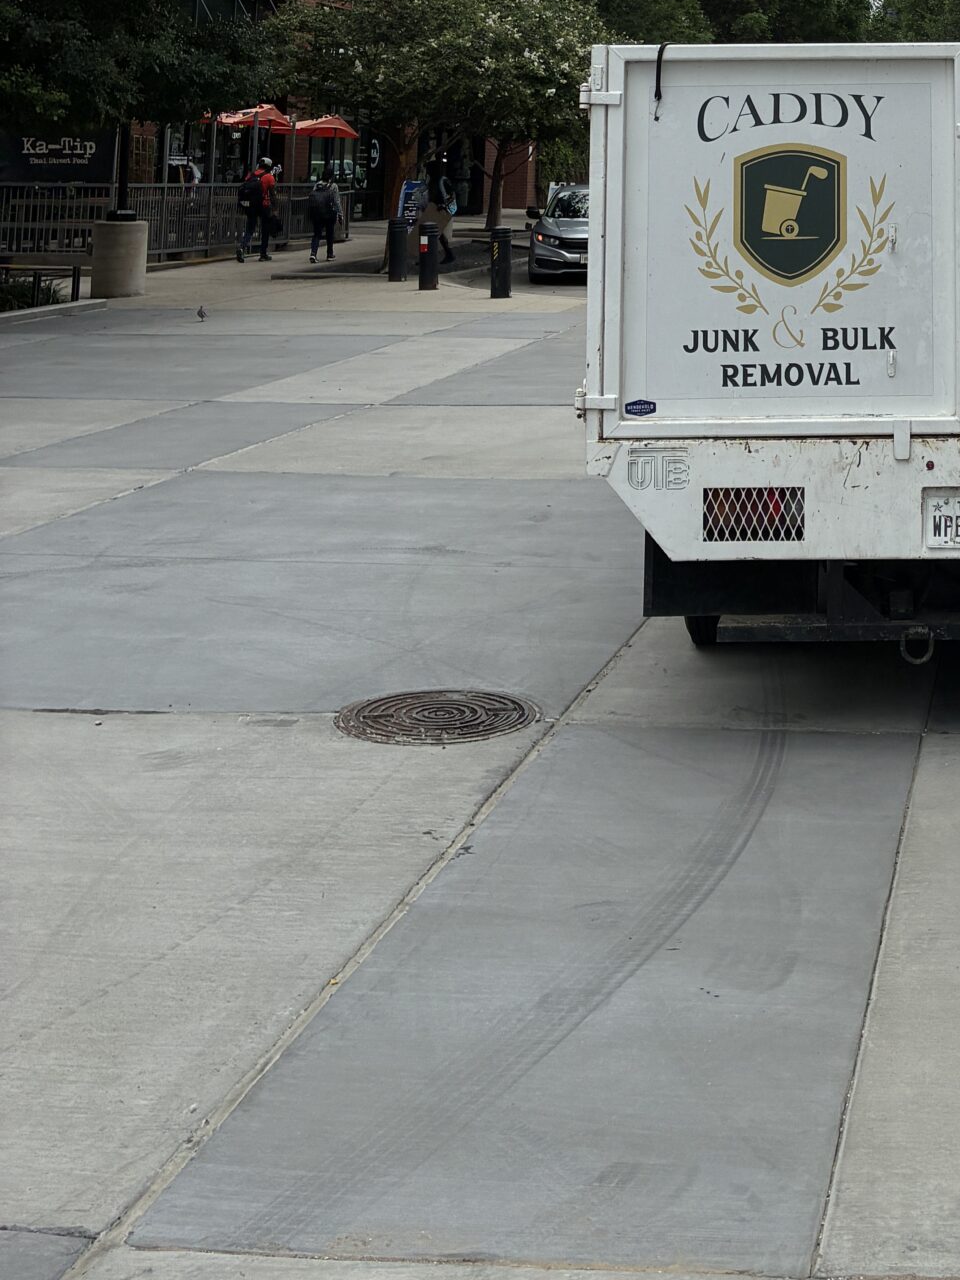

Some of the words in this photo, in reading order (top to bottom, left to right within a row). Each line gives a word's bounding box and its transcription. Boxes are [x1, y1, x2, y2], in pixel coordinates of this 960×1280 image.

[697, 92, 885, 142] CADDY
[21, 137, 96, 158] Ka-Tip
[683, 329, 760, 354] JUNK
[772, 305, 806, 349] &
[821, 326, 897, 351] BULK
[721, 362, 861, 388] REMOVAL
